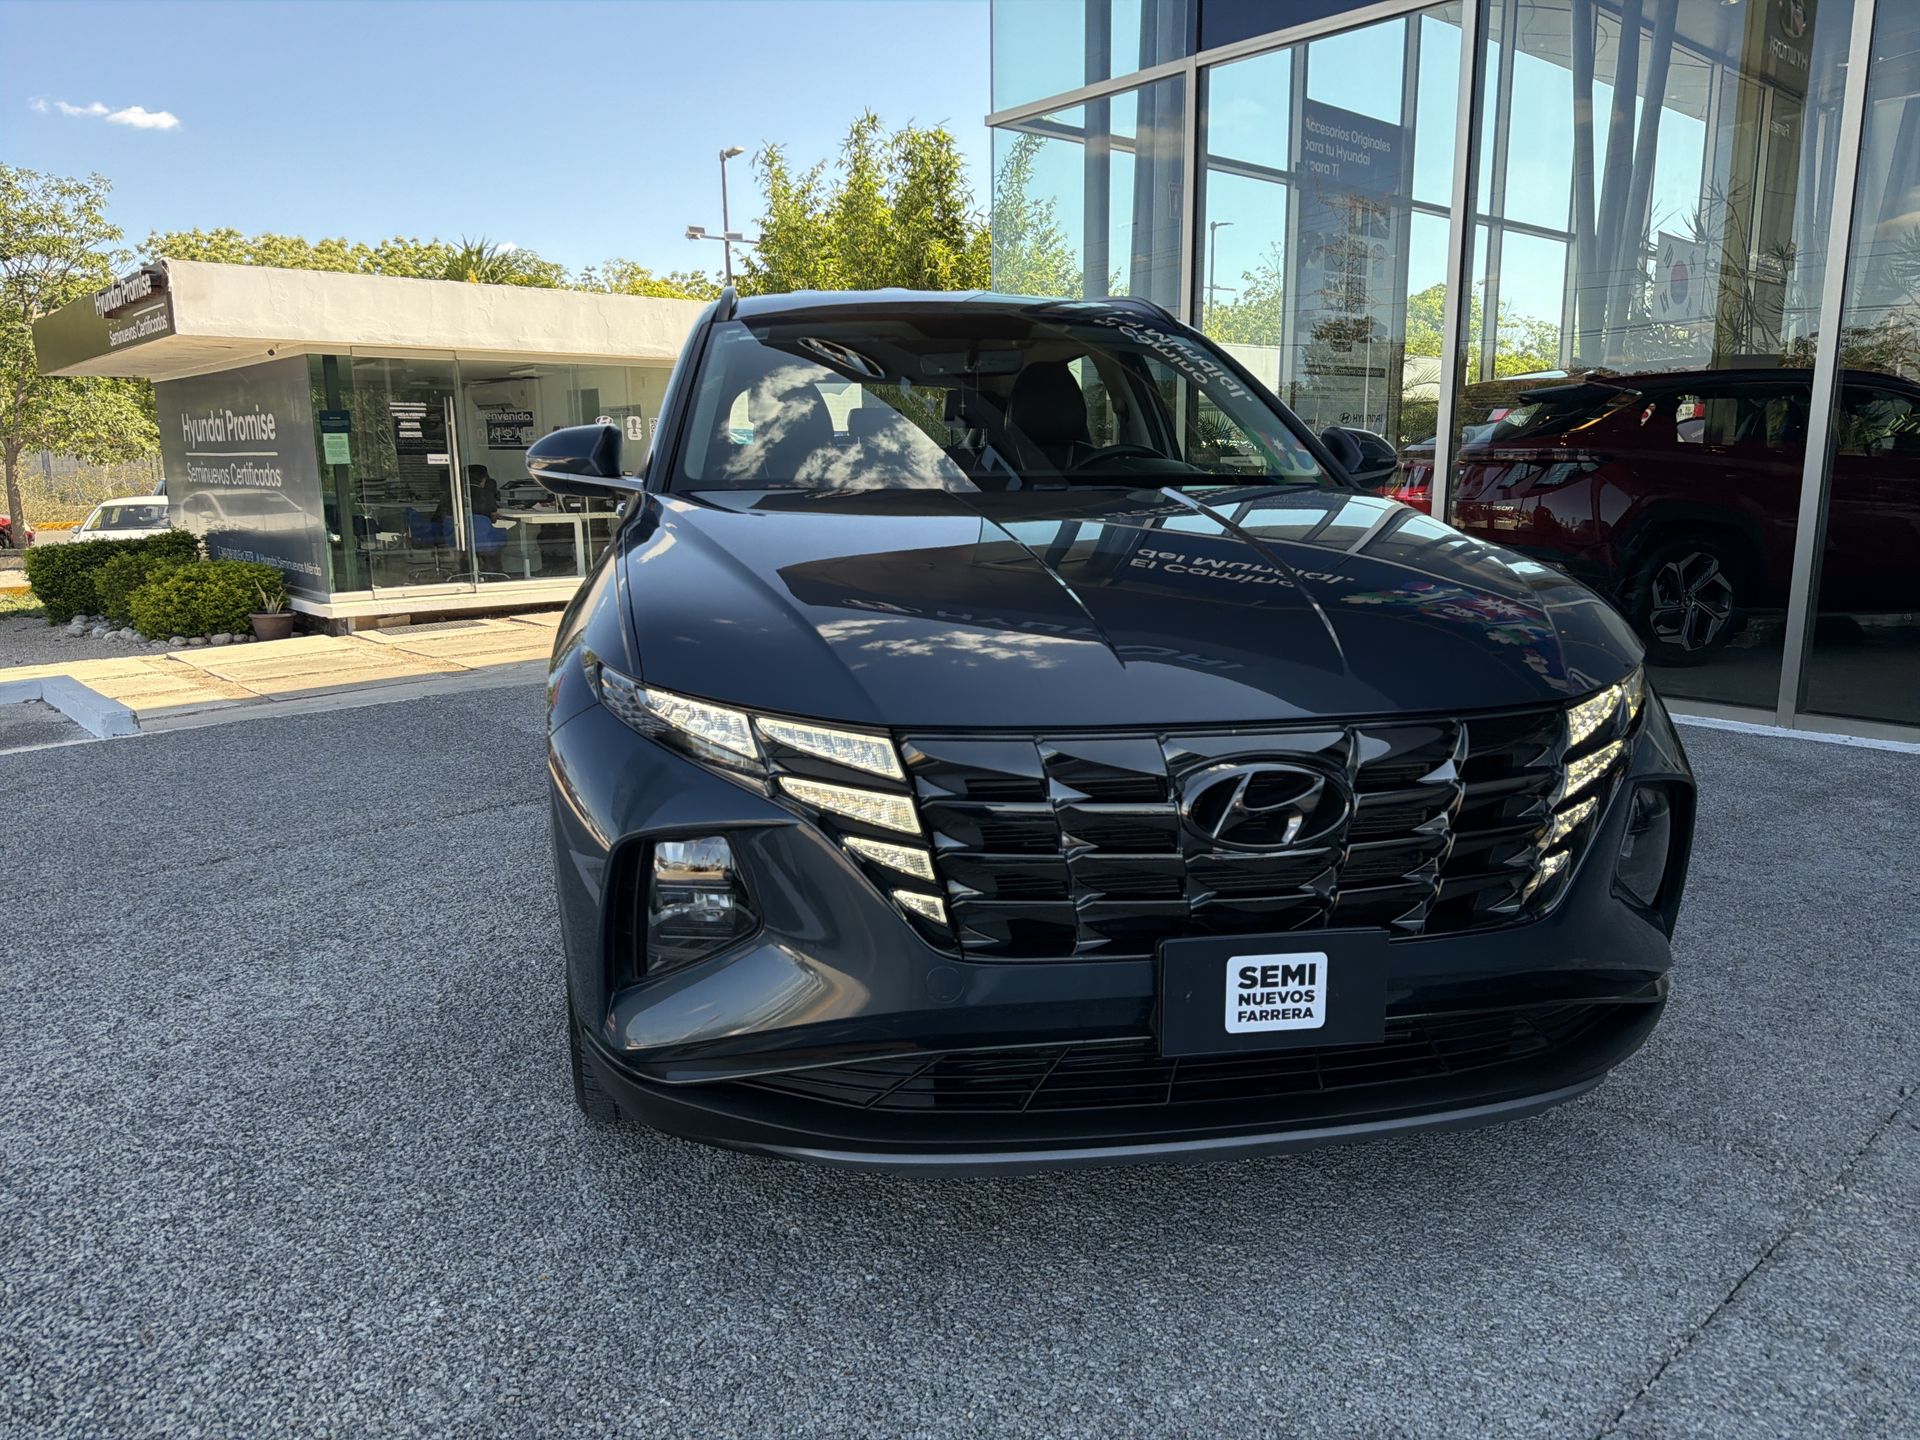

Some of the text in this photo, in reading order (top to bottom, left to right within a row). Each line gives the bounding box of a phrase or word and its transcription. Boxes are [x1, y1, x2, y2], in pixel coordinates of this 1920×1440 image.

[1325, 143, 1335, 157] tu
[1336, 144, 1371, 166] Hyundai
[1351, 130, 1391, 153] Originales
[94, 270, 152, 319] Hyundai Promise
[109, 312, 168, 347] Seminuevos Certificados
[181, 404, 276, 449] Hyundai Promise
[187, 461, 282, 488] Seminuevos Certificados
[1238, 963, 1317, 990] SEMI
[1238, 989, 1316, 1007] NUEVOS
[1237, 1006, 1315, 1023] FARRERA
